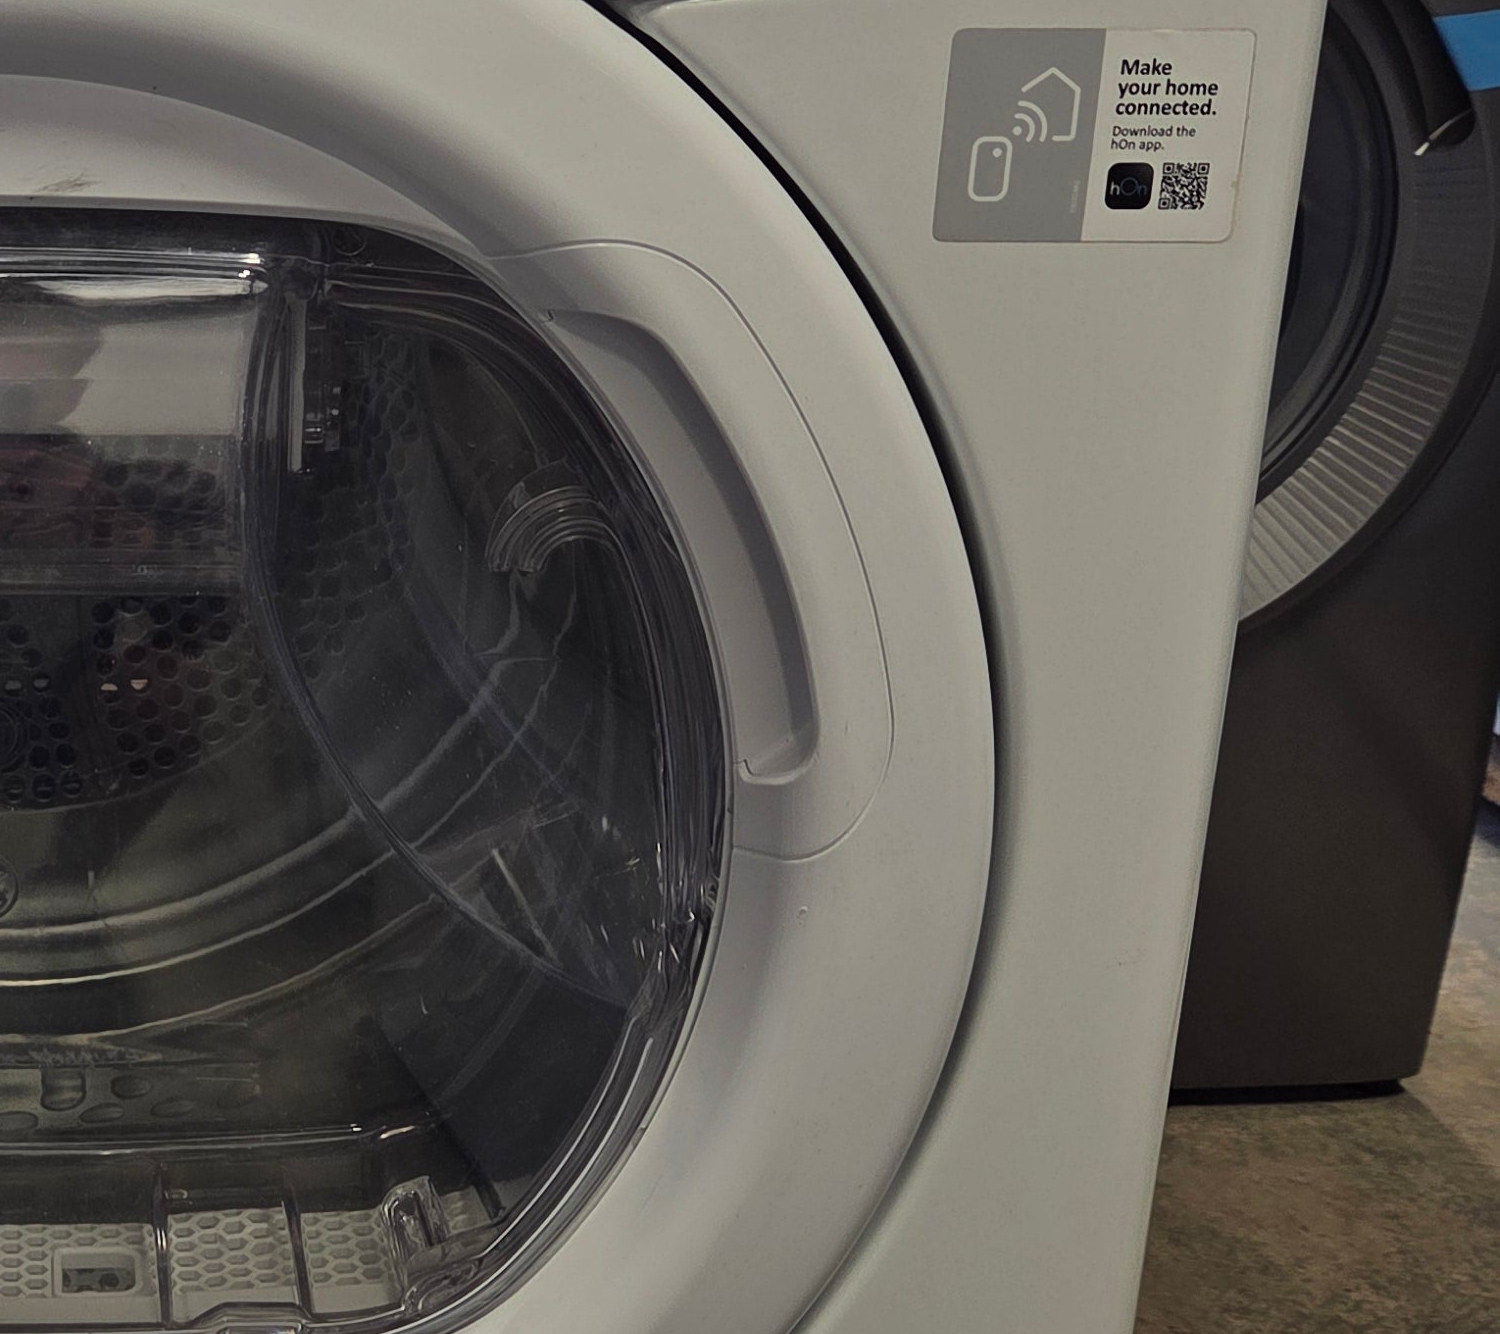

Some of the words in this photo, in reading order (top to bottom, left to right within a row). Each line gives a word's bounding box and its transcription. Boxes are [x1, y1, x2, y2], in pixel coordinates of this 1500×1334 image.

[1120, 58, 1173, 76] Make
[1117, 82, 1160, 99] your
[1165, 78, 1219, 96] home
[1115, 99, 1217, 116] connected.
[1112, 125, 1173, 138] Download
[1177, 125, 1196, 138] the
[1110, 139, 1136, 151] hOn
[1139, 142, 1165, 152] app.
[1109, 176, 1148, 196] hOn
